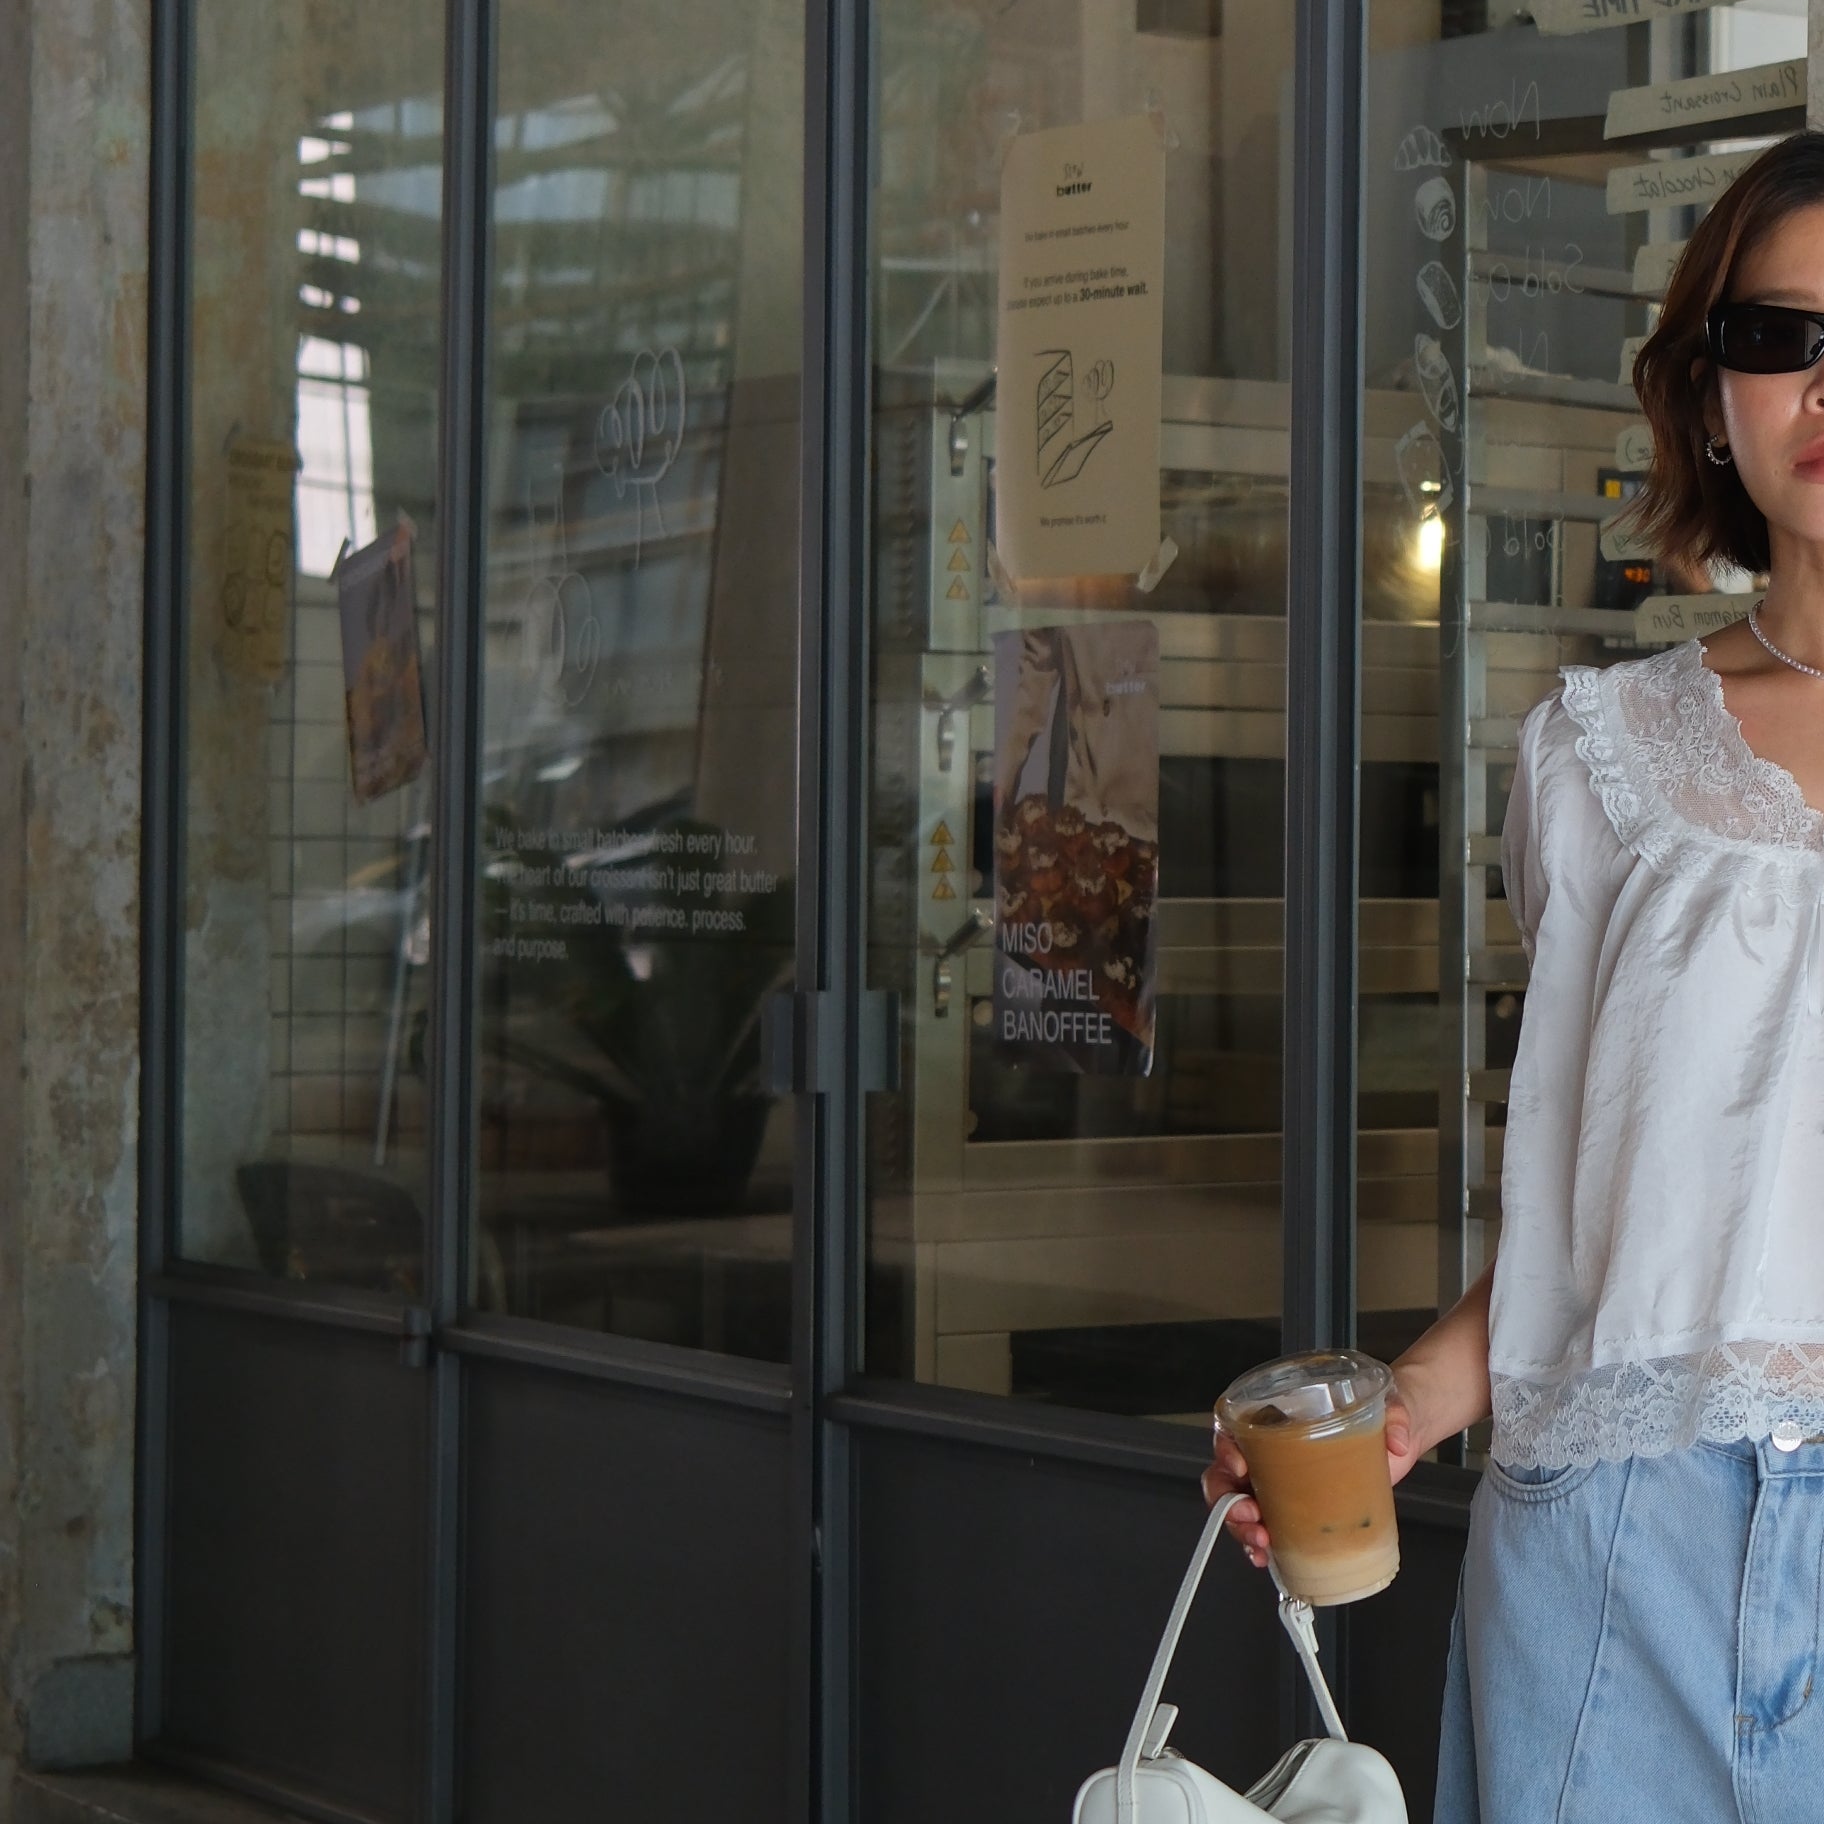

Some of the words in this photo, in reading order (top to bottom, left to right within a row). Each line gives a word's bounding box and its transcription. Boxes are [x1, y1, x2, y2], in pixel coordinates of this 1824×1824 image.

[1056, 180, 1093, 197] butter
[1080, 285, 1125, 302] 30-minute
[687, 833, 722, 860] every
[553, 863, 566, 887] of
[677, 866, 700, 896] just
[703, 869, 737, 898] great
[739, 868, 778, 893] butter
[560, 899, 602, 924] crafted
[604, 902, 629, 925] with
[1002, 922, 1052, 954] MISO
[1002, 966, 1100, 1001] CARAMEL
[1003, 1010, 1113, 1045] BANOFFEE
